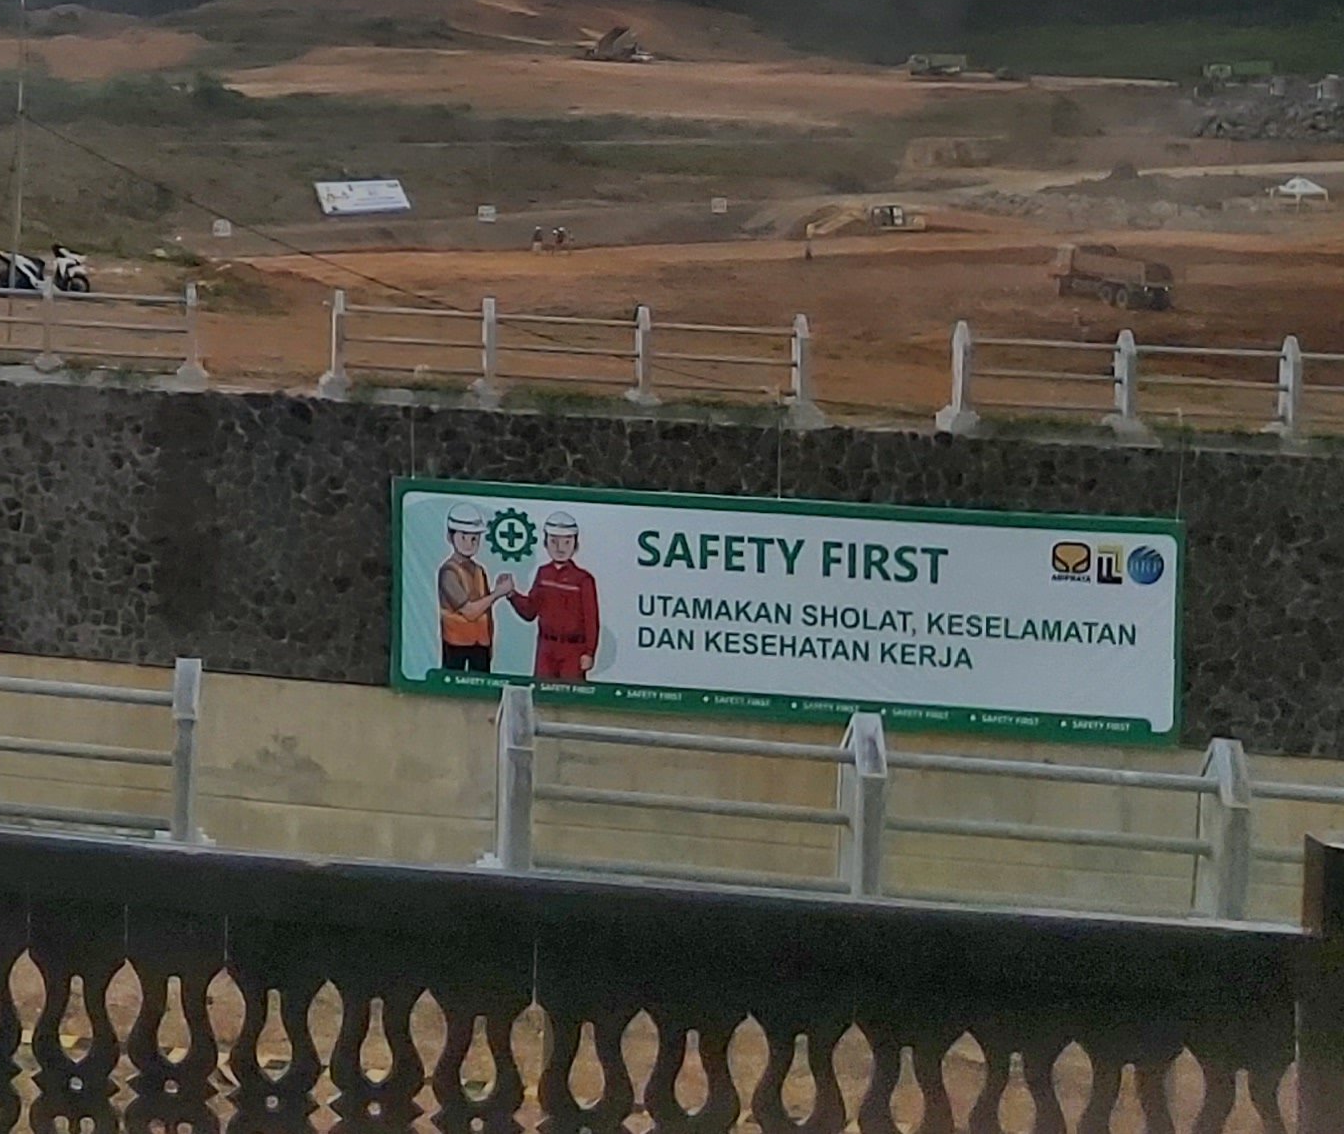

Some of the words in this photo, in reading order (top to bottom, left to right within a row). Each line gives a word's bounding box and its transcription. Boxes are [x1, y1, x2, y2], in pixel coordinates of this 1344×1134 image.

[637, 530, 805, 575] SAFETY
[822, 541, 949, 584] FIRST
[637, 594, 792, 626] UTAMAKAN
[801, 604, 917, 636] SHOLAT,
[927, 613, 1137, 646] KESELAMATAN
[637, 627, 695, 651] DAN
[704, 630, 870, 663] KESEHATAN
[879, 641, 974, 669] KERJA
